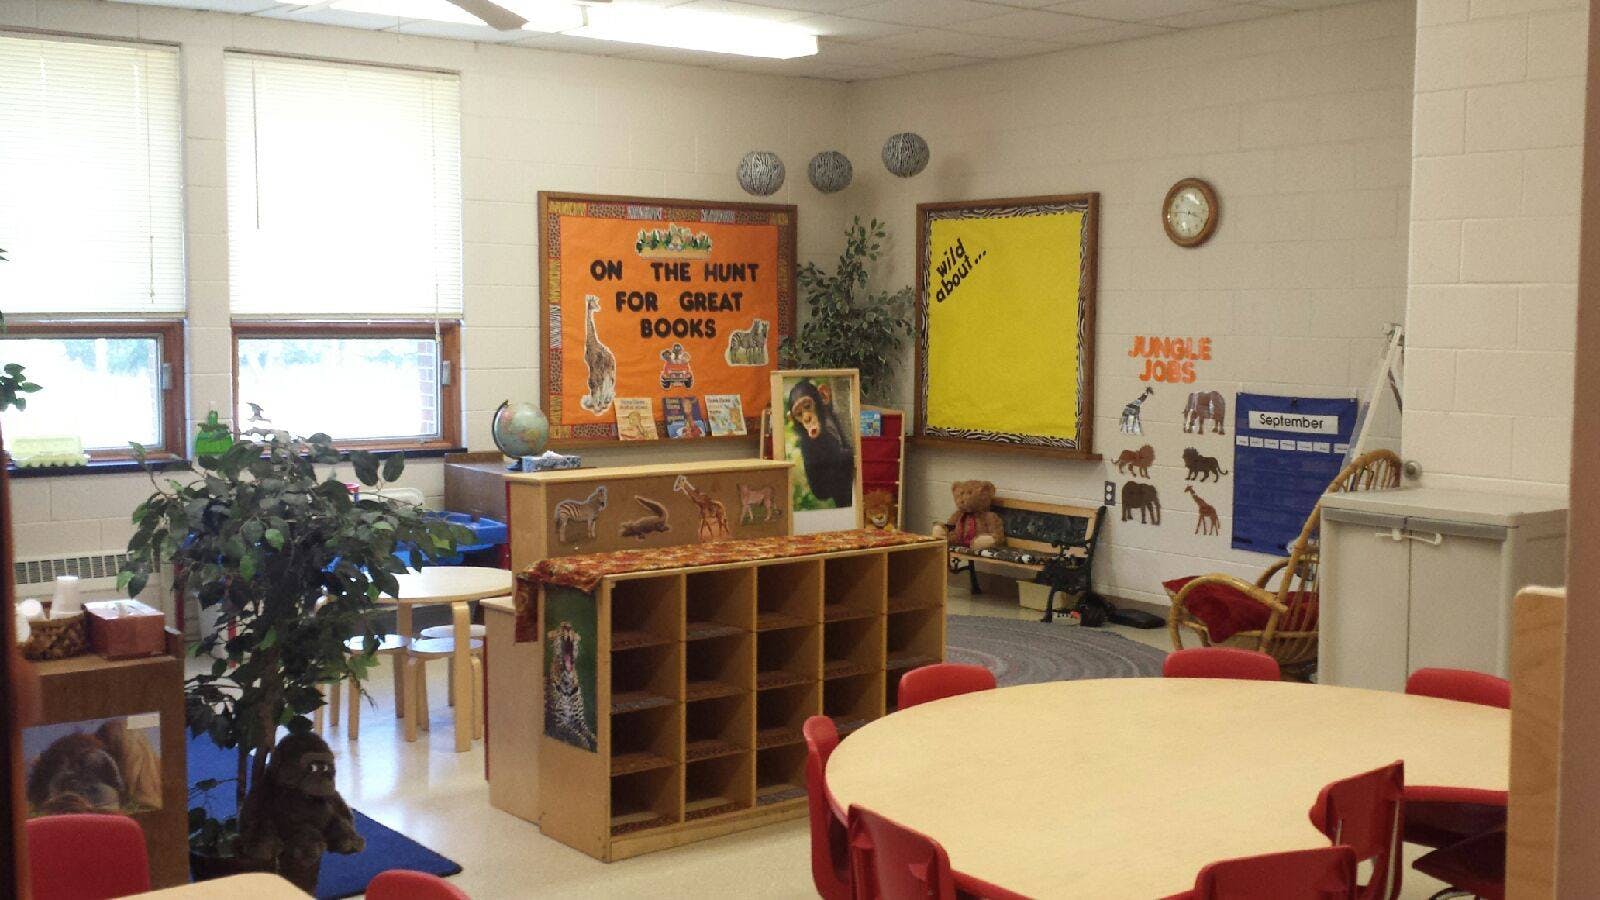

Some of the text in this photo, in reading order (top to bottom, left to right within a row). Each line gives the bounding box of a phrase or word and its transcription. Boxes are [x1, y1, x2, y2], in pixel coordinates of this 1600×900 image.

[936, 238, 965, 278] wild
[590, 259, 759, 282] ON THE HUNT
[615, 291, 743, 312] FOR GREAT
[640, 318, 717, 339] BOOKS
[1127, 335, 1213, 361] JUNGLE
[1138, 359, 1197, 384] JOBS
[1260, 413, 1324, 430] September
